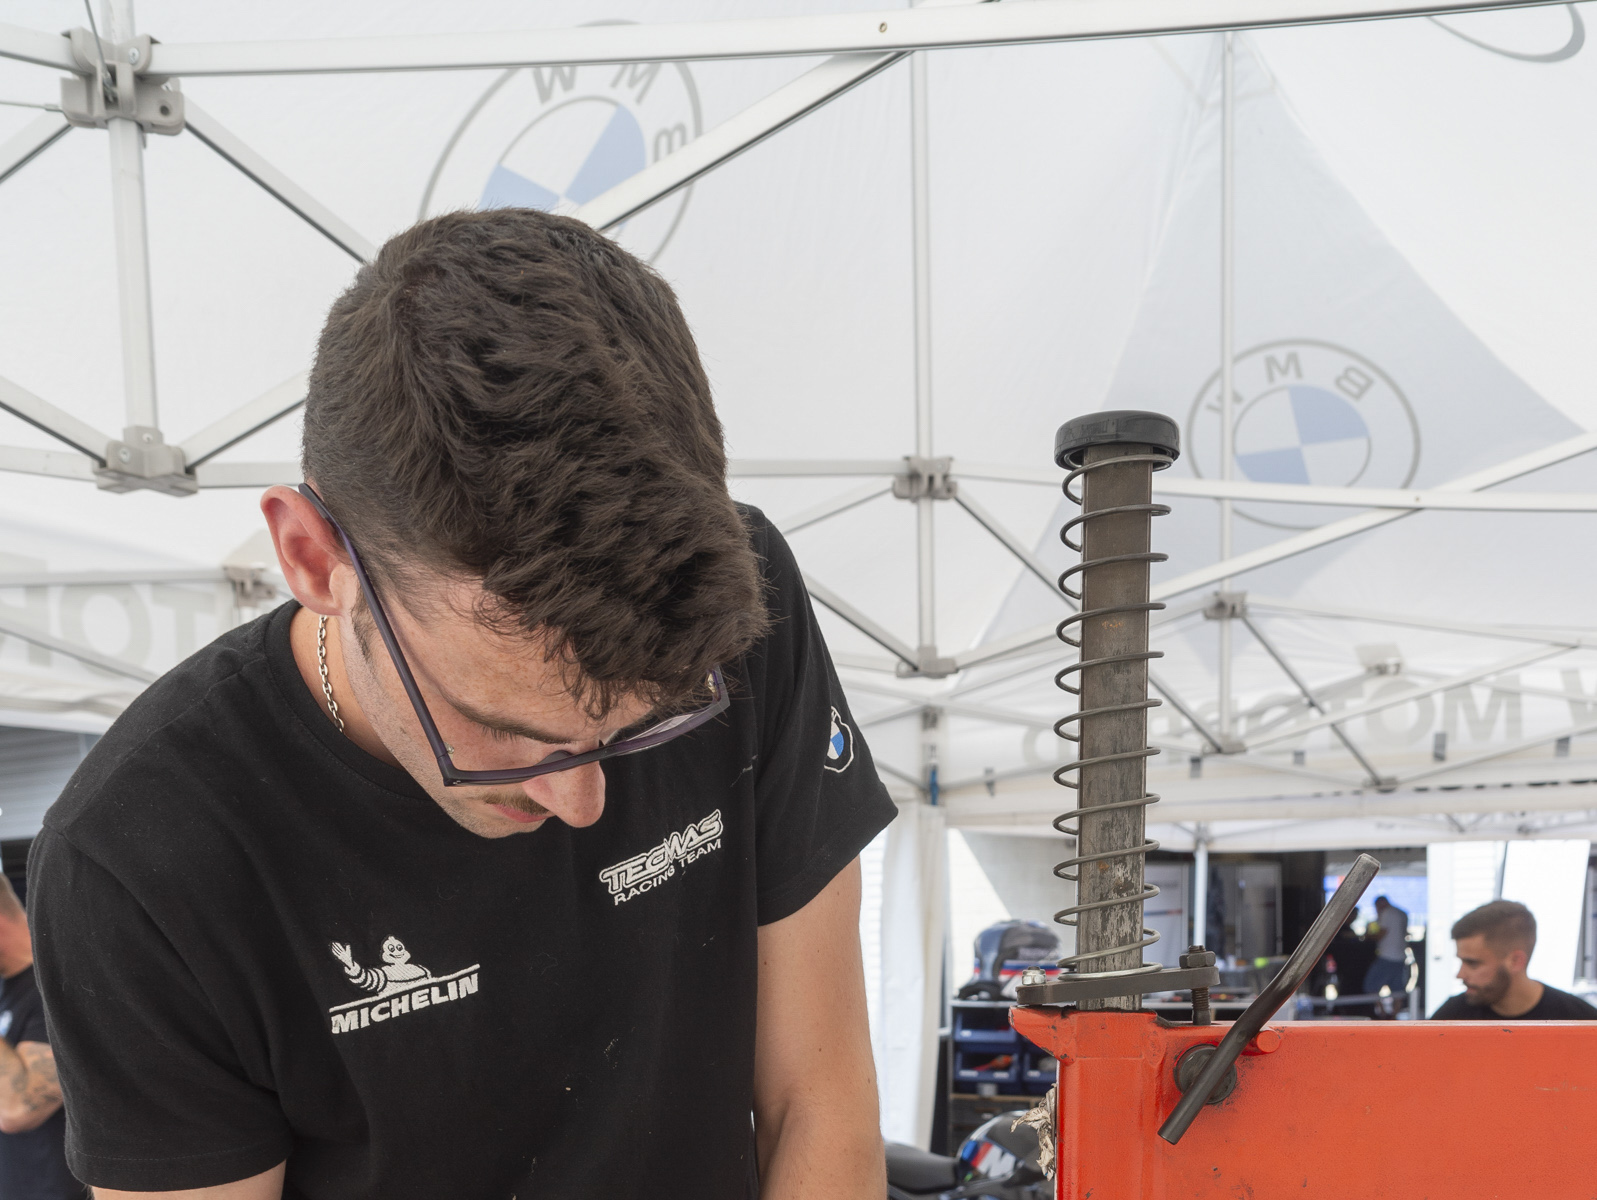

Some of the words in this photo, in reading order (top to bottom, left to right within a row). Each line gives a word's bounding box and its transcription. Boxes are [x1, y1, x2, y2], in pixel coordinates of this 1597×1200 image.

[614, 865, 675, 906] RACING
[679, 838, 722, 868] TEAM
[331, 972, 479, 1034] MICHELIN
